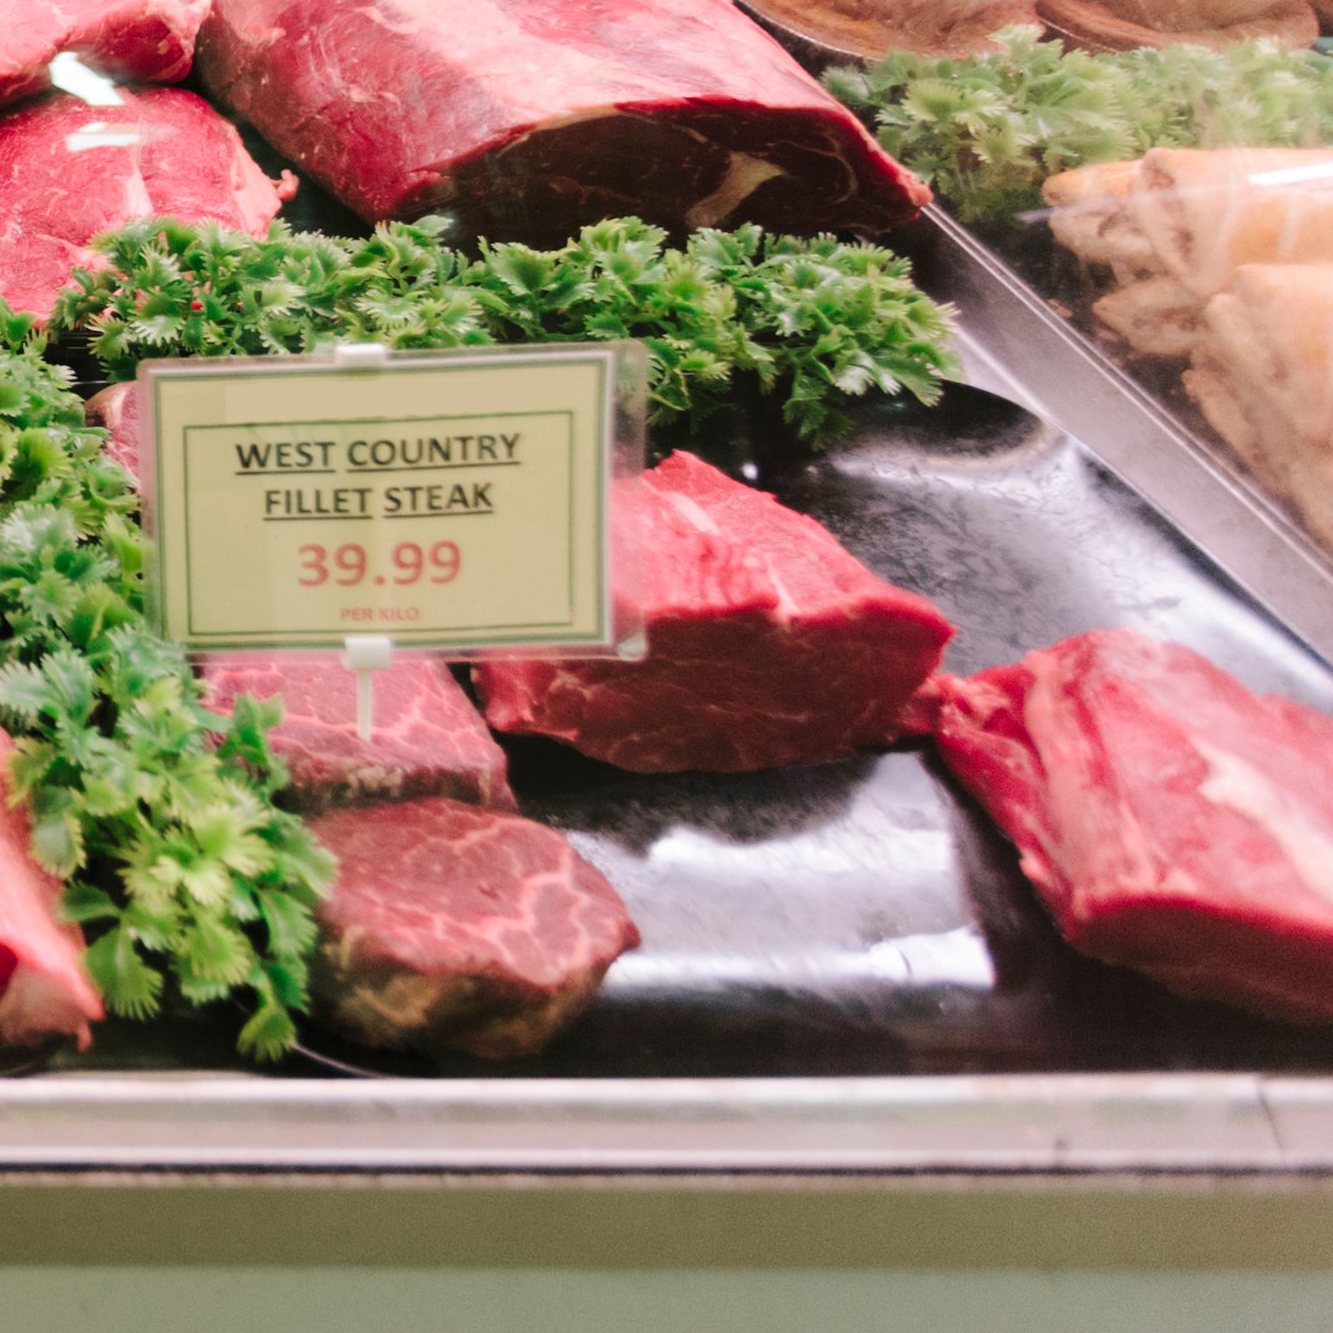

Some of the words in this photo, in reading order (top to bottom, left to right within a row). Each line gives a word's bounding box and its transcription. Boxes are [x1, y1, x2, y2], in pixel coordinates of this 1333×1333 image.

[235, 441, 335, 468] WEST
[347, 432, 521, 466] COUNTRY
[264, 488, 372, 515] FILLET
[384, 482, 493, 511] STEAK
[297, 540, 461, 587] 39.99
[340, 607, 374, 622] PER
[379, 606, 420, 621] KILO
